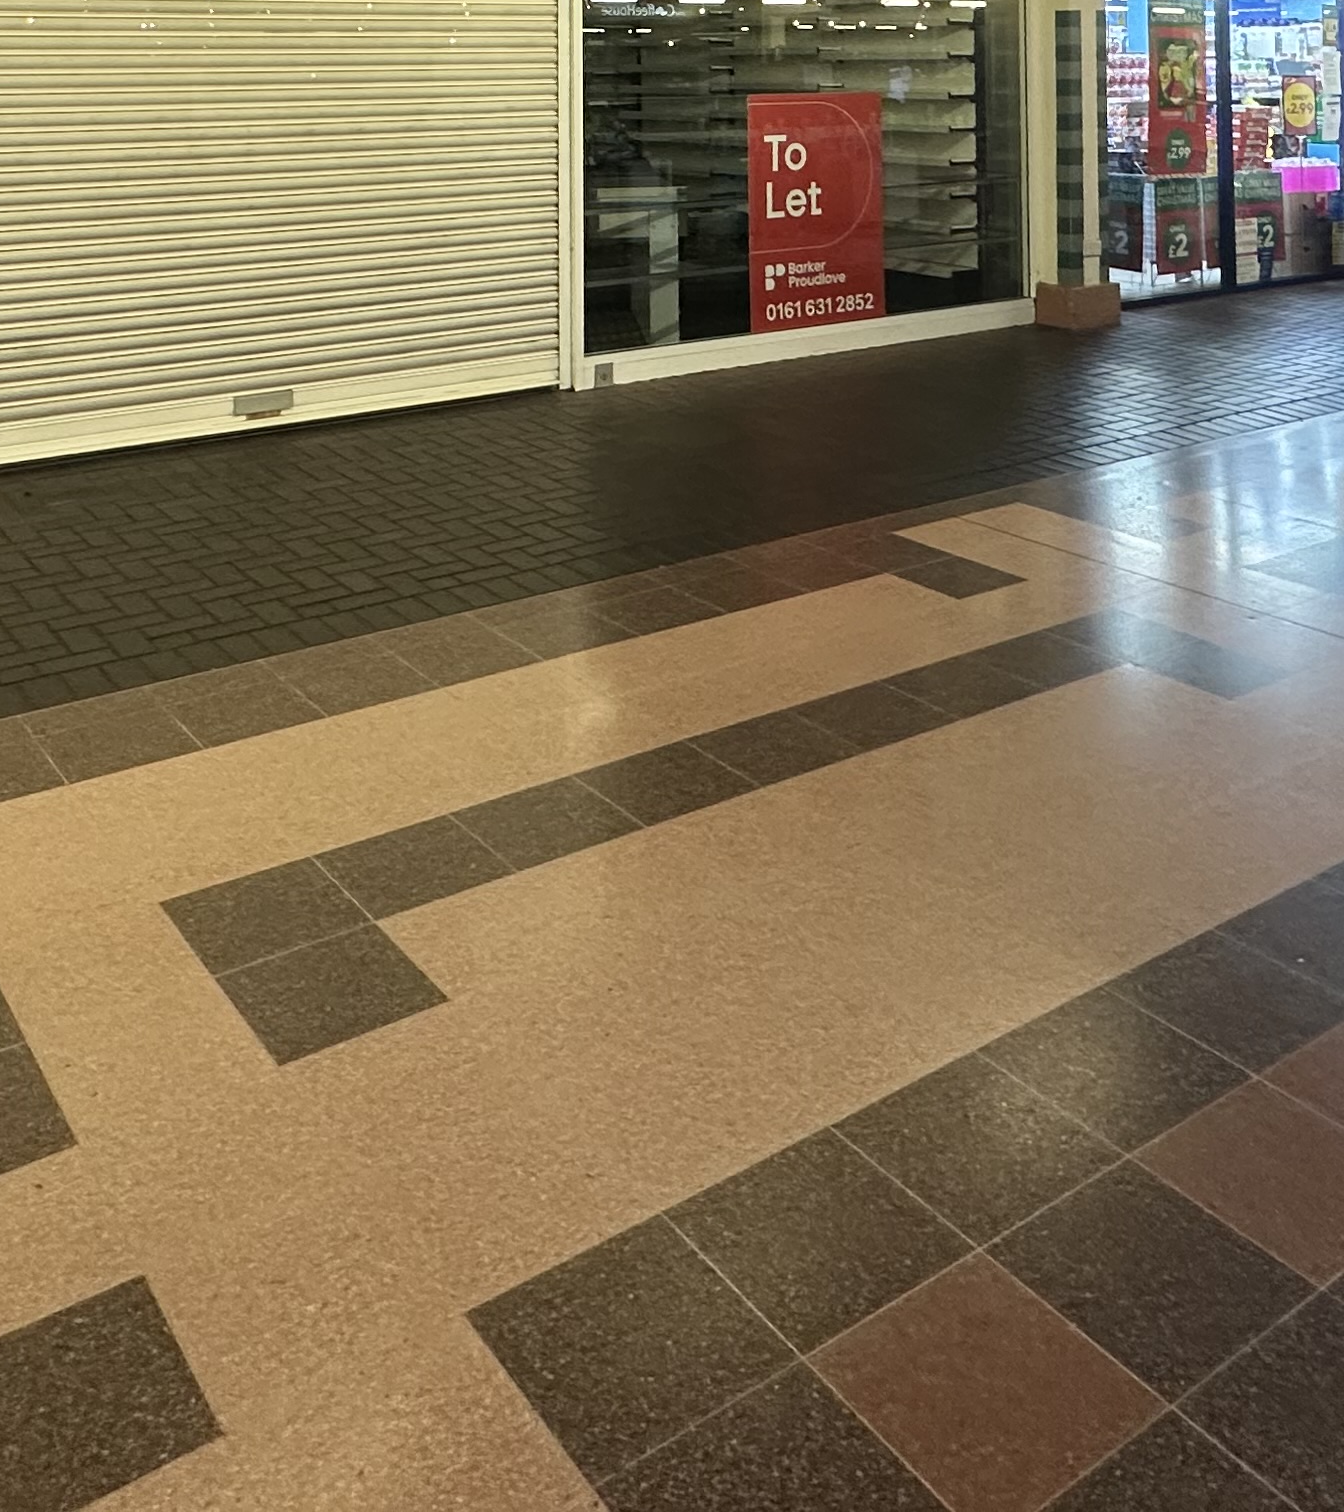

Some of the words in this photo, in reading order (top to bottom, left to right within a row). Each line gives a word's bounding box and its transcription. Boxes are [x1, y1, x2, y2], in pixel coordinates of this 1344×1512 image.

[763, 134, 808, 172] To
[764, 180, 823, 219] Let
[1168, 232, 1189, 258] £2
[787, 260, 826, 275] Barker
[788, 273, 846, 288] Proudlove
[766, 300, 802, 321] 0161
[805, 297, 833, 316] 631
[836, 292, 874, 313] 2852
